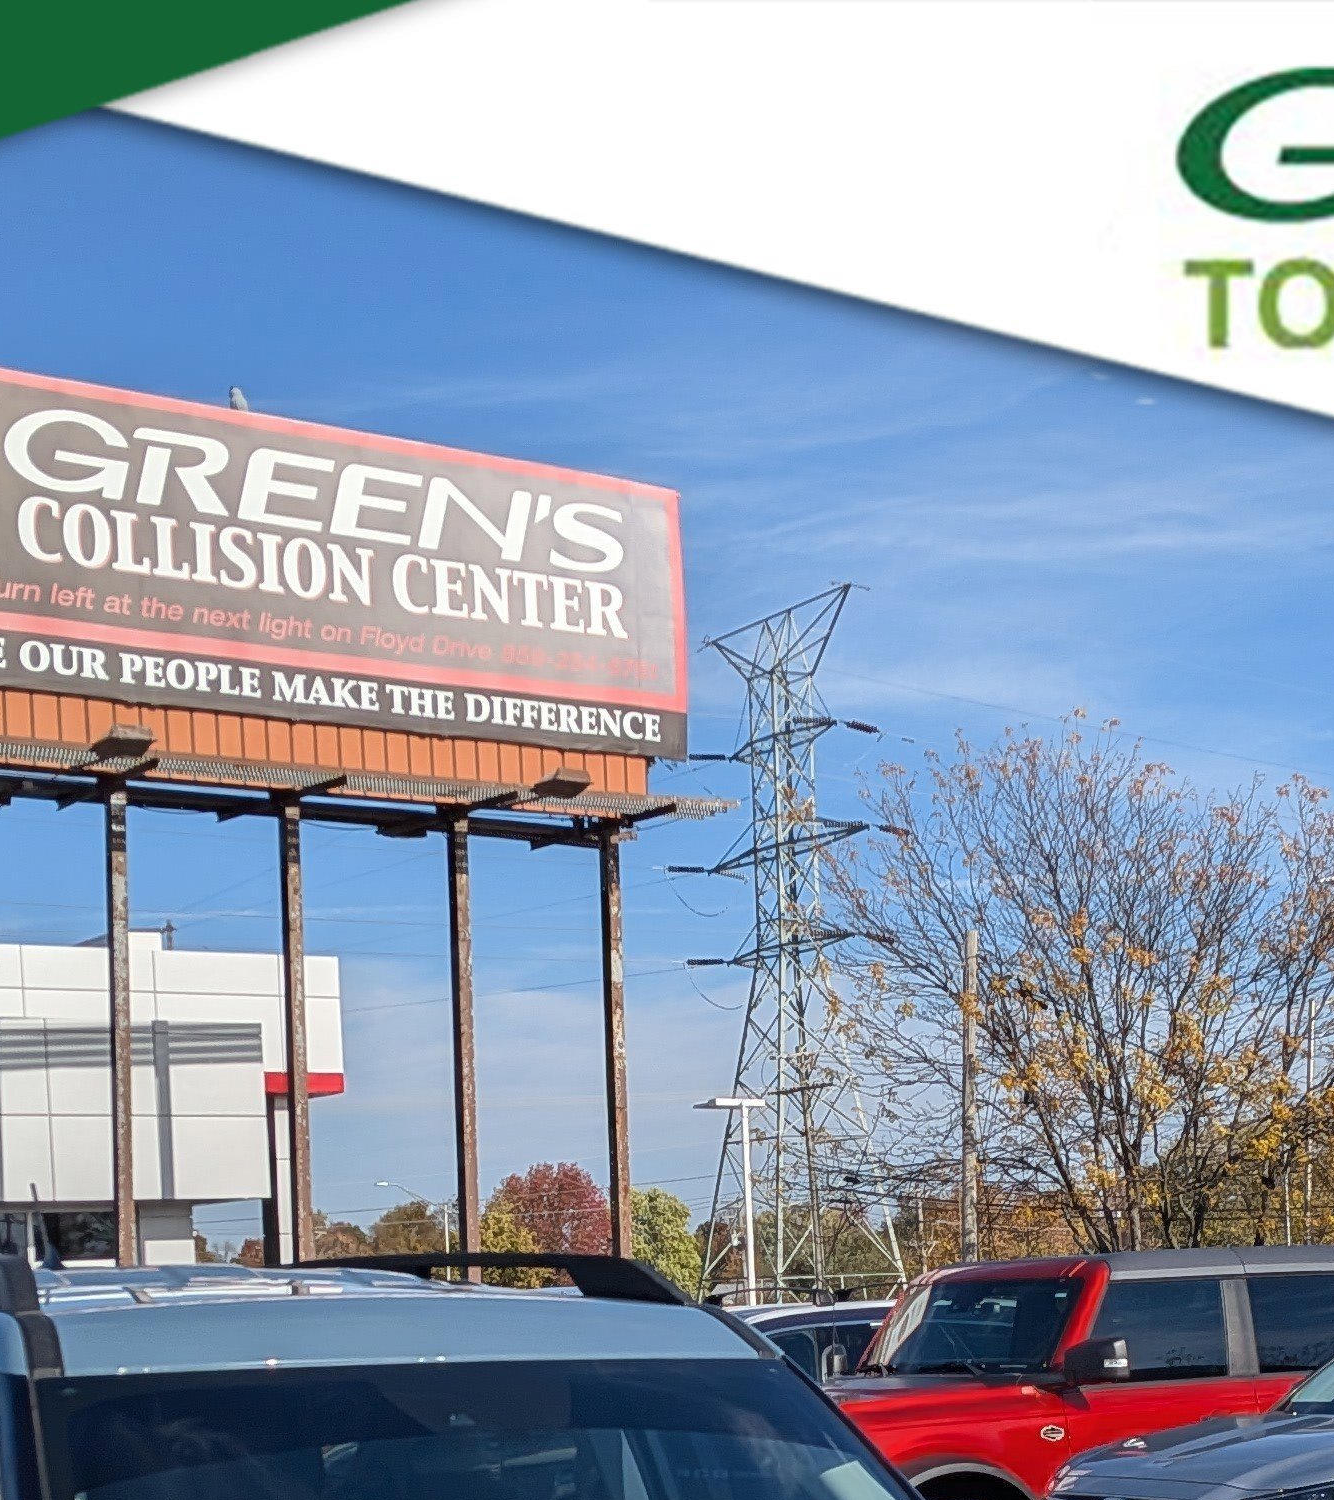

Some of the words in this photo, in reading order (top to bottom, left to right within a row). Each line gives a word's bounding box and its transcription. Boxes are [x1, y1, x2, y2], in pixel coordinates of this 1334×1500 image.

[3, 409, 624, 573] GREEN'S
[18, 495, 374, 608] COLLISION
[392, 553, 629, 640] CENTER
[49, 582, 96, 610] left
[102, 593, 132, 616] at
[140, 596, 184, 622] the
[191, 605, 251, 632] next
[257, 611, 313, 640] light
[320, 623, 352, 643] on
[360, 625, 426, 655] Floyd
[433, 634, 493, 661] Drive
[18, 639, 110, 681] OUR
[118, 652, 262, 700] PEOPLE
[271, 670, 380, 712] MAKE
[385, 684, 455, 721] THE
[463, 691, 662, 743] DIFFERENCE
